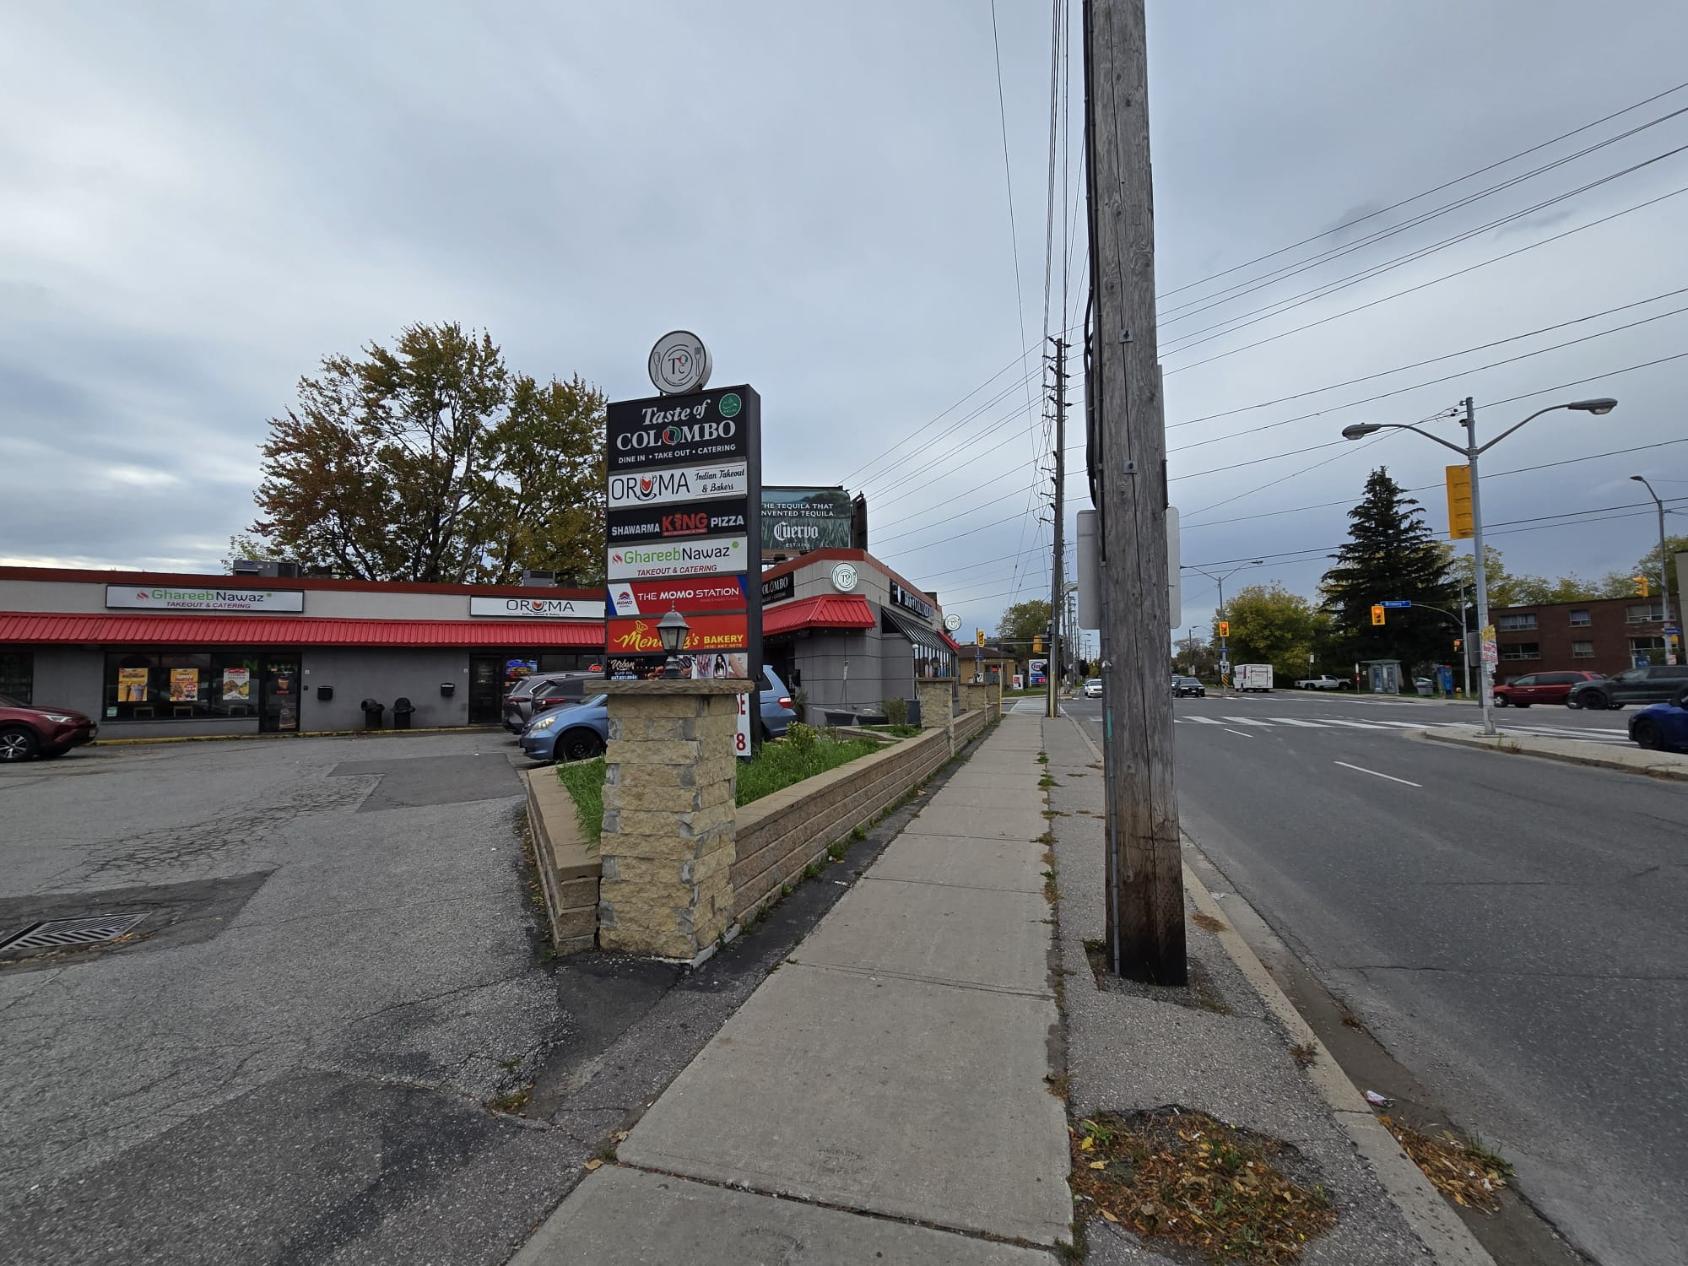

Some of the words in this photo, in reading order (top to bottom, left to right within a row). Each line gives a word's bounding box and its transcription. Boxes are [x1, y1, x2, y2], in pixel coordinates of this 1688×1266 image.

[641, 407, 690, 426] Taste
[693, 399, 711, 420] of
[616, 420, 736, 451] COLOMBO
[618, 455, 637, 464] DINE
[637, 454, 646, 462] IN
[654, 451, 673, 460] TAKE
[674, 449, 690, 458] OUT
[697, 443, 736, 454] CATERING
[611, 522, 660, 536] SHAWARMA
[661, 512, 708, 531] KING
[711, 515, 745, 528] PIZZA
[773, 521, 819, 541] Cuervo
[637, 567, 671, 577] TAKEOUT
[672, 566, 678, 574] &
[679, 564, 718, 574] CATERING
[637, 592, 657, 601] THE
[659, 590, 694, 600] MOMO
[696, 587, 739, 597] STATION
[703, 634, 744, 644] BAKERY
